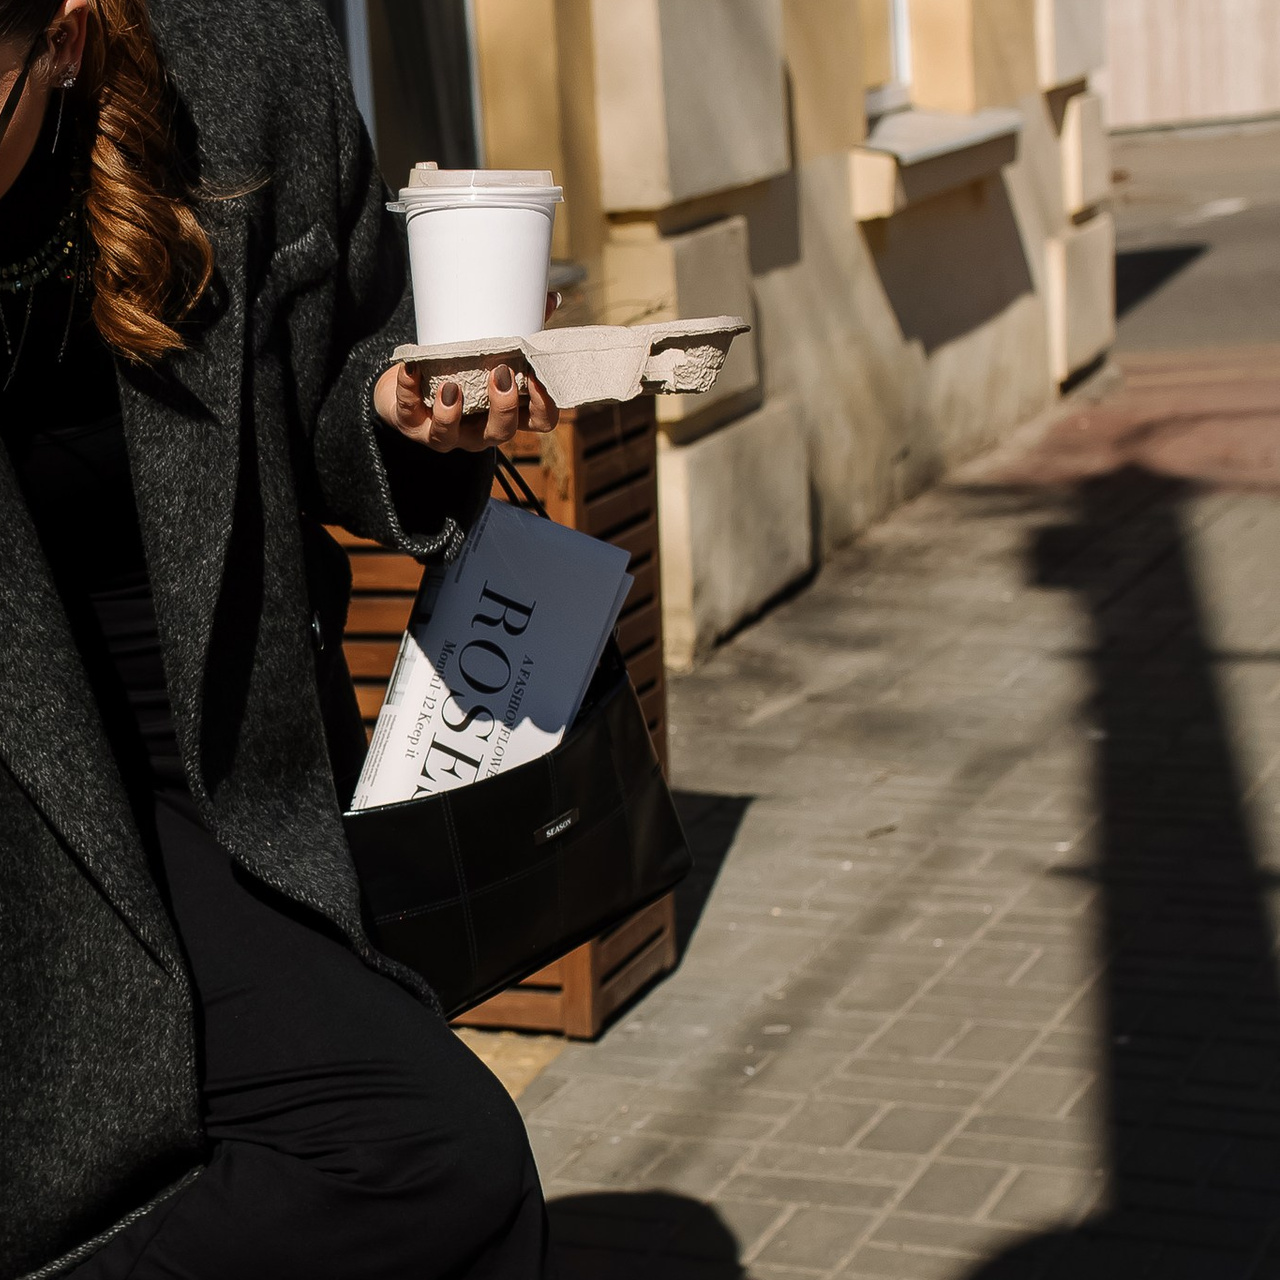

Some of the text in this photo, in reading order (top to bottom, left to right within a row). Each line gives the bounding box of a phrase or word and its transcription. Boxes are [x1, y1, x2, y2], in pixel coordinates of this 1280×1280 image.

[524, 654, 534, 667] A
[407, 712, 432, 745] Keep
[405, 750, 419, 760] it
[545, 817, 572, 838] SEASON
